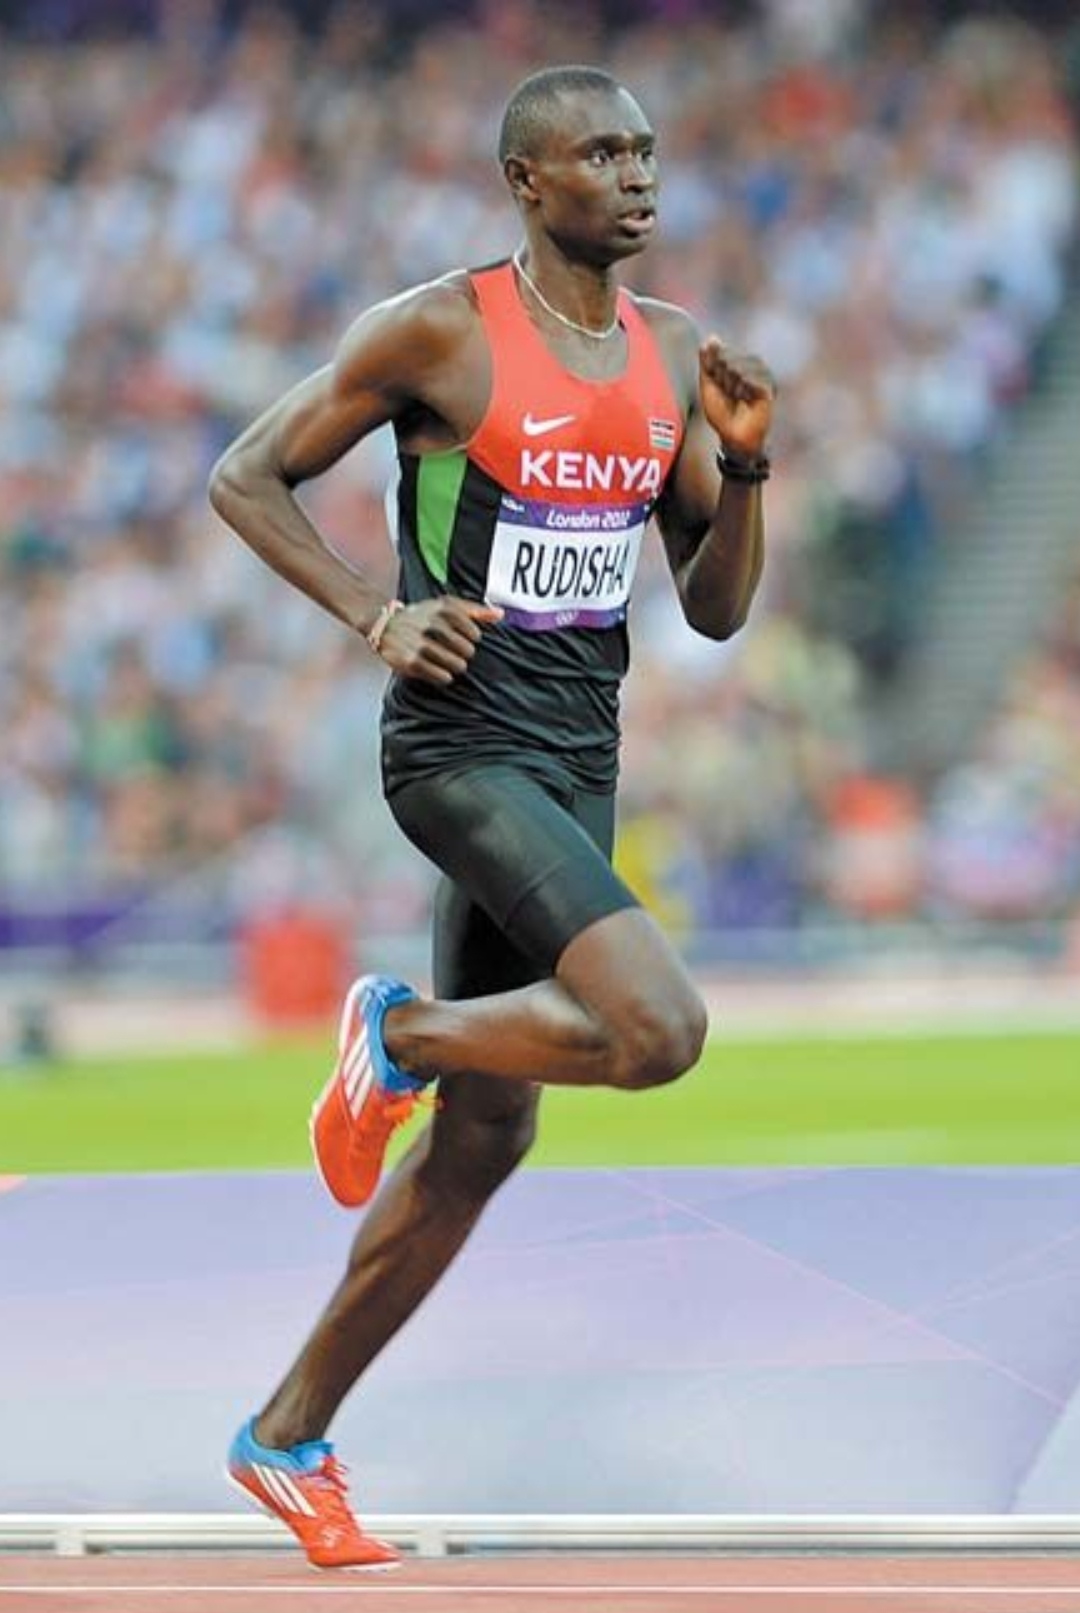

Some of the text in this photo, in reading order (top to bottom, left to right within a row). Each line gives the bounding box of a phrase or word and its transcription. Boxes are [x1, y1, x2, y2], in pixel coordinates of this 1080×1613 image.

[520, 449, 661, 496] KENYA
[546, 509, 600, 527] London
[511, 541, 630, 597] RUDISHA
